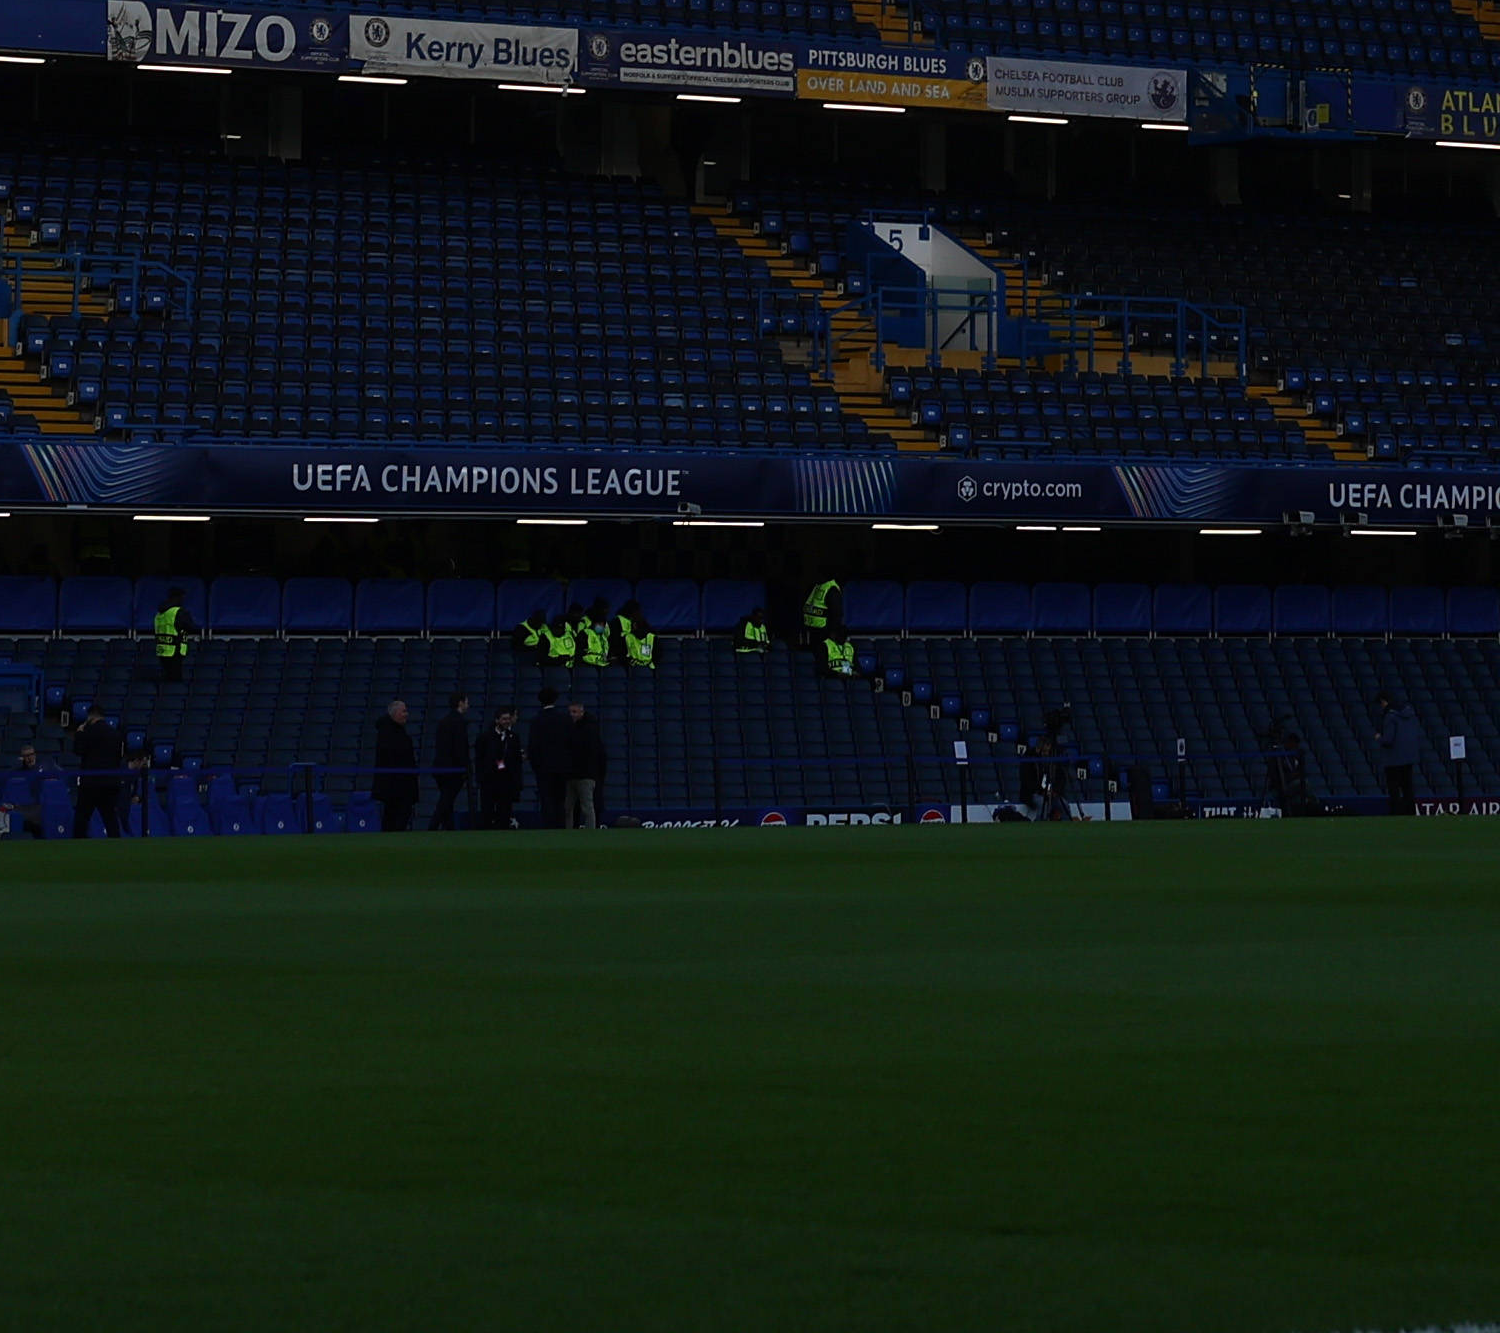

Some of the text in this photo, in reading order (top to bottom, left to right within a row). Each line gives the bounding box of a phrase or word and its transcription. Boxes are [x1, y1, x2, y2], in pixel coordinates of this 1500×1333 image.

[406, 33, 484, 68] Kerry
[493, 38, 570, 68] Blues
[620, 38, 794, 72] easternblues
[809, 49, 946, 74] PITTSBURGH BLUES
[807, 77, 949, 99] OVER LAND AND SEA
[995, 69, 1124, 87] CHELSEA FOOTBALL CLUB
[996, 86, 1140, 105] MUSLIM SUPPORTERS GROUP
[889, 230, 903, 253] 5
[292, 464, 371, 492] UEFA
[381, 464, 558, 495] CHAMPIONS
[983, 480, 1082, 500] crypto.com
[1329, 482, 1392, 508] UEFA
